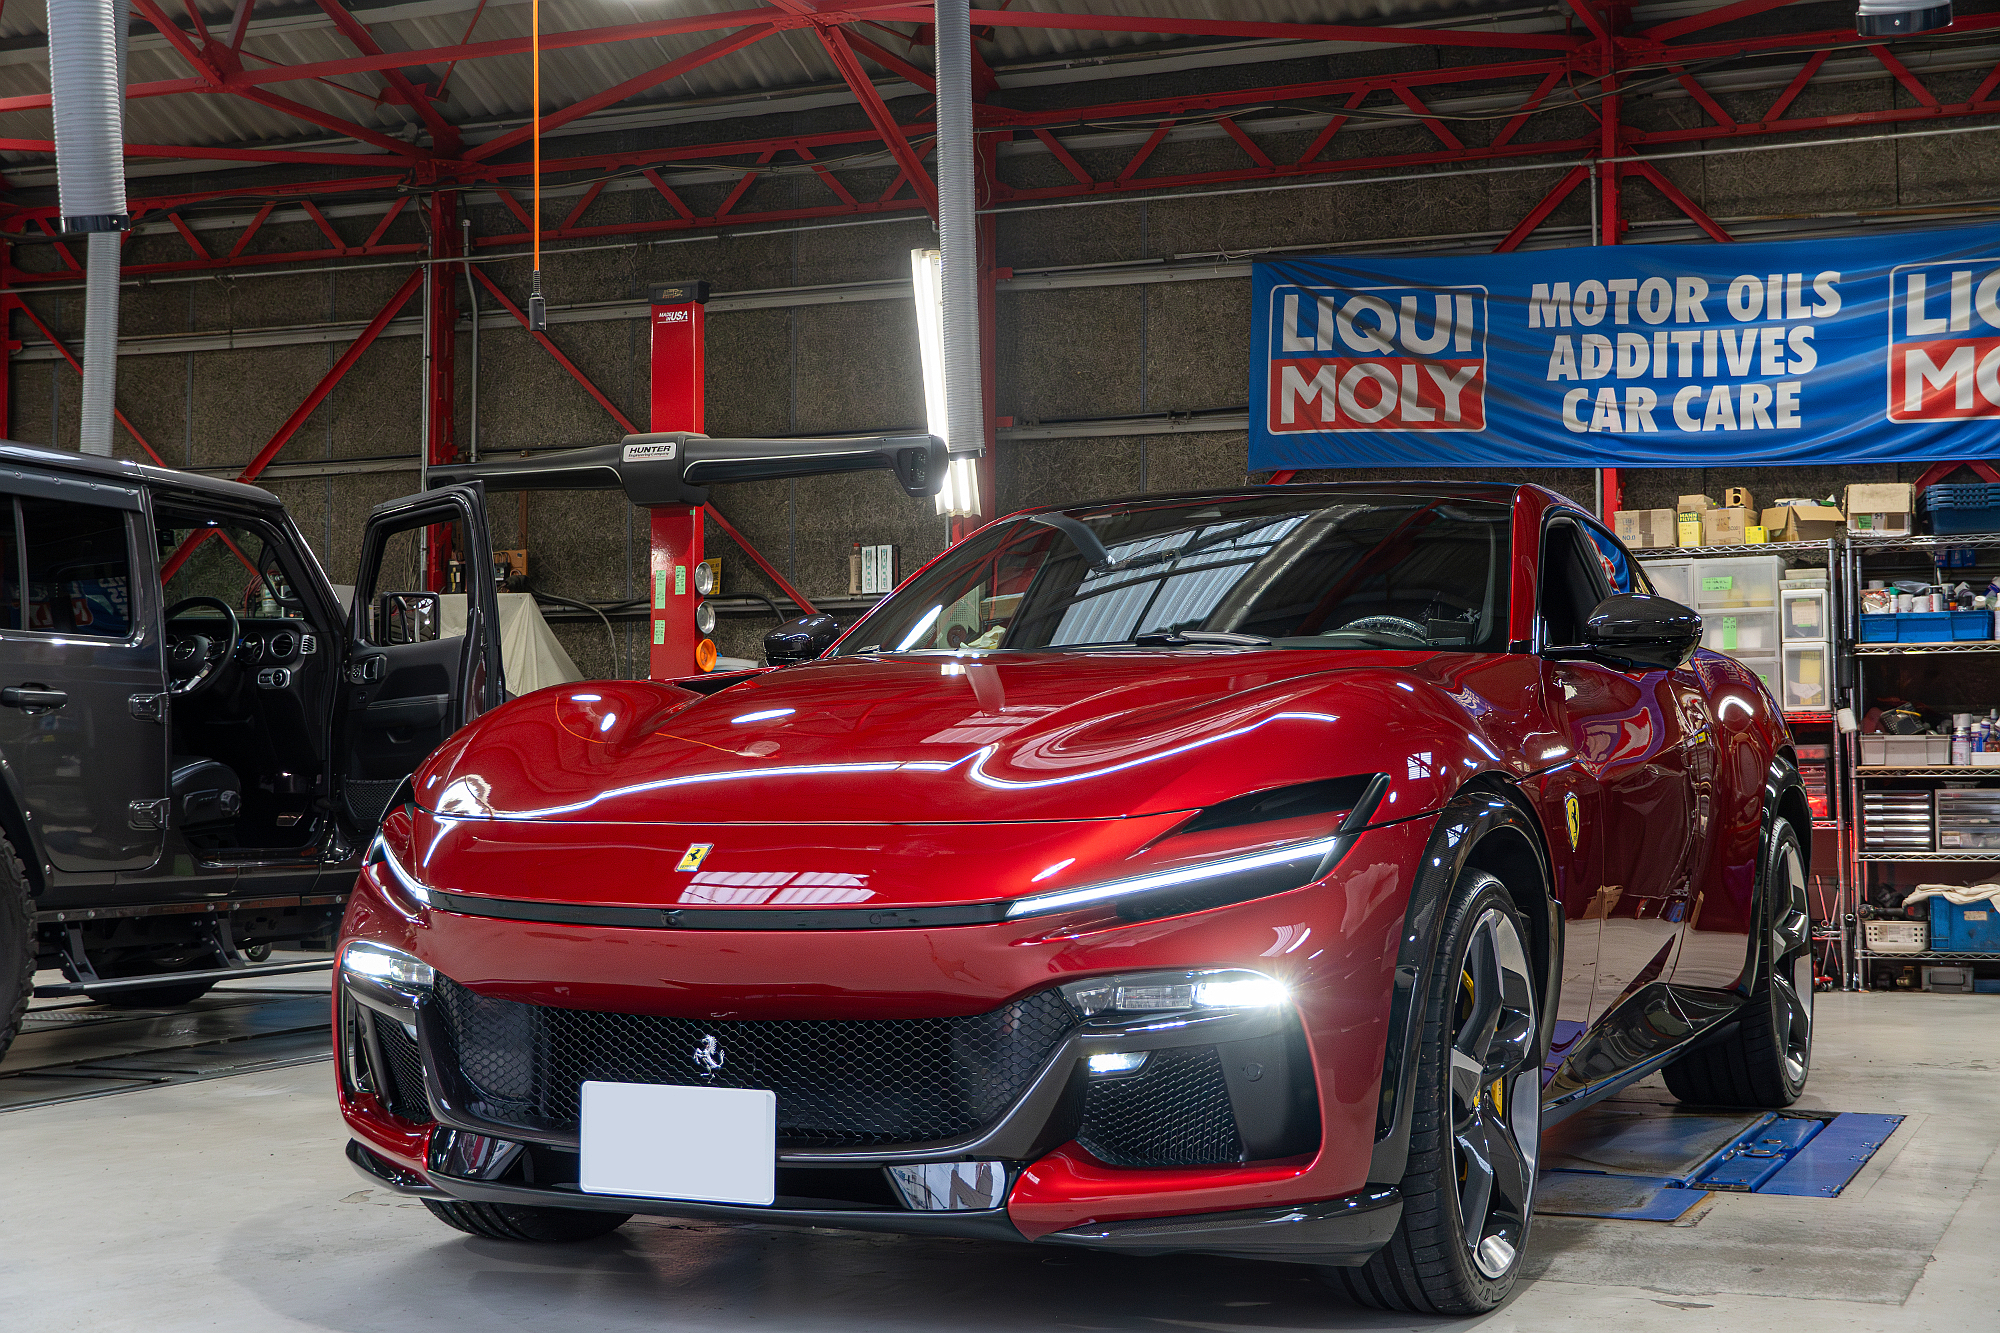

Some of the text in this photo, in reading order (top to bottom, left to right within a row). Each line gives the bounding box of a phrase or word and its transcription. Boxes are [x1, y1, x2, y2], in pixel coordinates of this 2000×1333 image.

[671, 310, 688, 320] USA
[1282, 294, 1474, 356] LIQUI
[1528, 270, 1842, 328] MOTOR OILS
[1546, 325, 1818, 381] ADDITIVES
[1280, 362, 1481, 425] MOLY
[1562, 380, 1802, 434] CAR CARE
